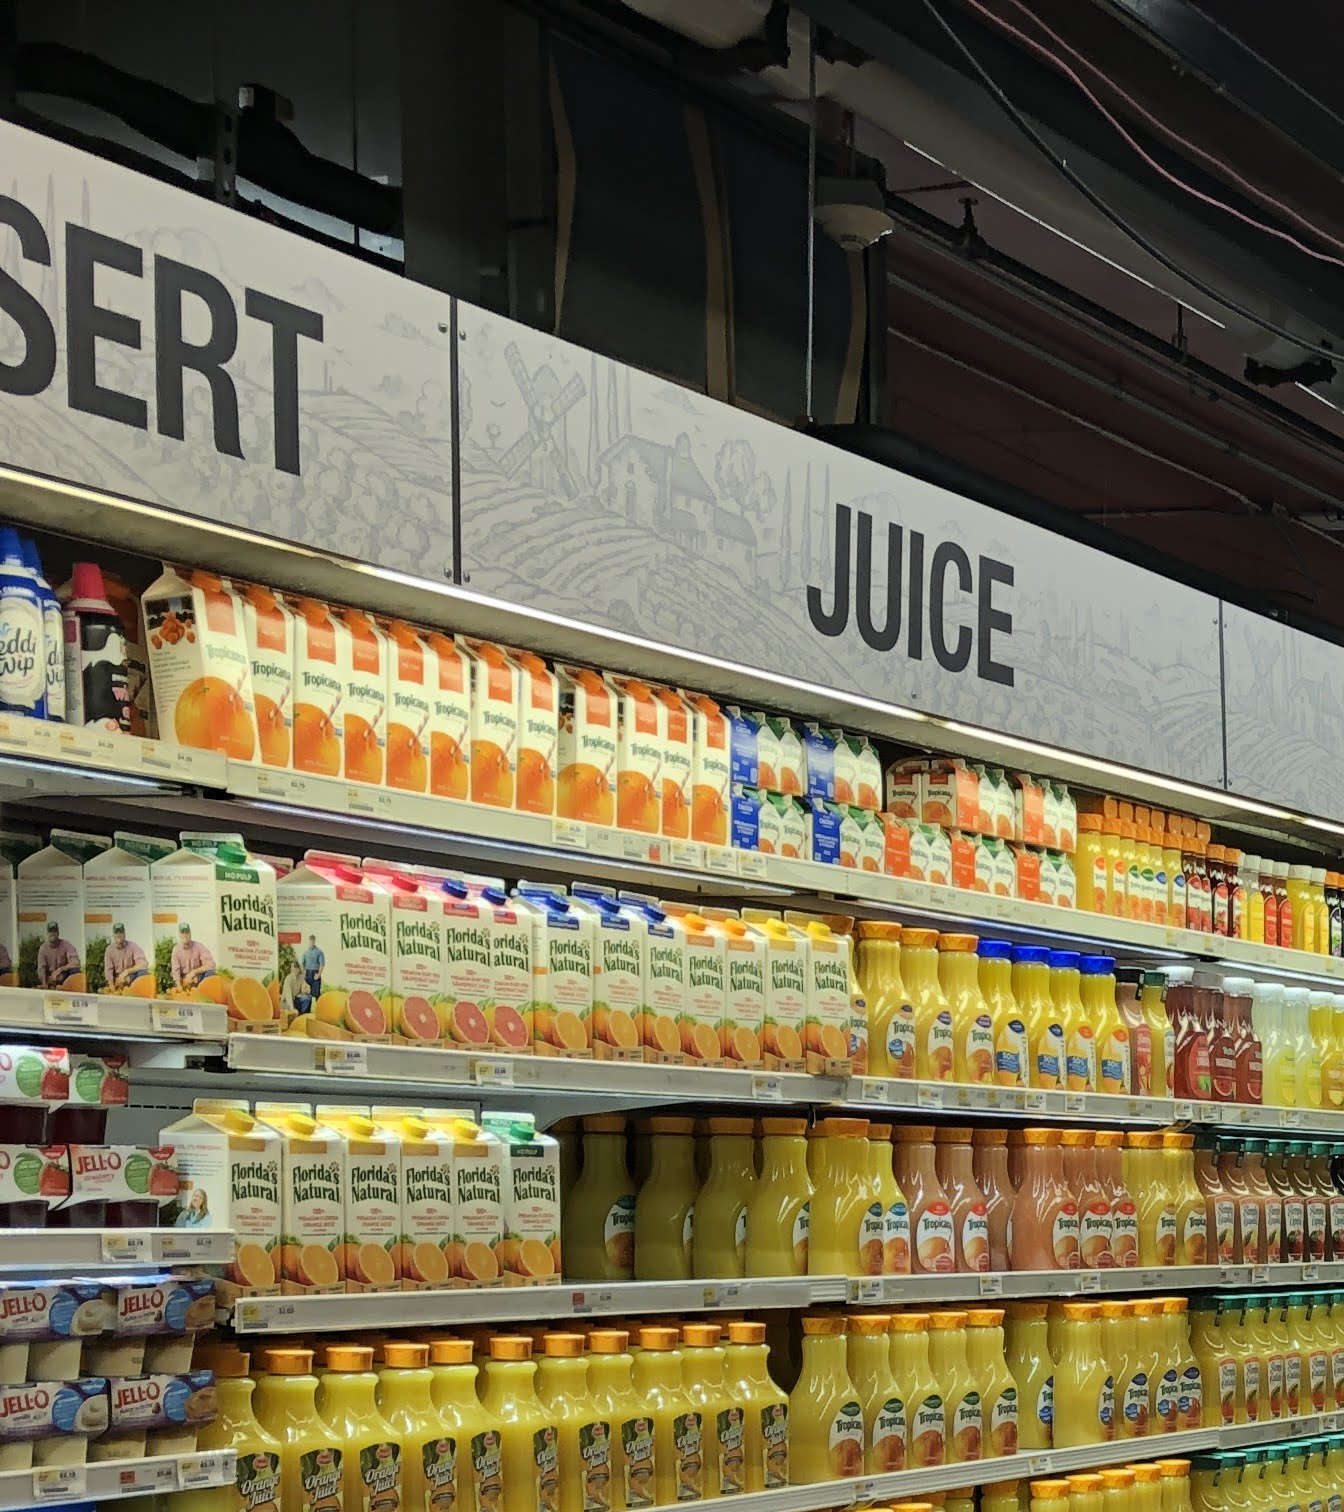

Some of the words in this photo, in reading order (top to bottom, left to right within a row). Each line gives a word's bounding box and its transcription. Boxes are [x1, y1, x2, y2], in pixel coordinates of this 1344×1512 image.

[806, 504, 1015, 687] JUICE
[0, 627, 37, 656] eddi
[251, 660, 291, 682] Tropicana
[302, 671, 342, 693] Tropicana
[348, 683, 385, 703] Tropicana
[581, 734, 616, 754] Tropicana
[221, 894, 274, 919] Florida's
[221, 914, 274, 937] Natural
[340, 913, 386, 937] Florida's
[396, 920, 440, 944] Florida's
[340, 932, 387, 954] Natural
[397, 940, 440, 961] Natural
[550, 939, 590, 961] Florida's
[550, 956, 590, 977] Natural
[231, 1161, 278, 1185] Florida's
[293, 1162, 340, 1184] Florida's
[457, 1165, 500, 1186] Florida's
[231, 1182, 279, 1203] Natural
[293, 1182, 340, 1203] Natural
[457, 1185, 500, 1204] Natural
[924, 1217, 952, 1230] Tropica
[120, 1290, 164, 1316] JELL-O
[114, 1382, 160, 1408] JELL-O
[879, 1414, 905, 1429] Tropica
